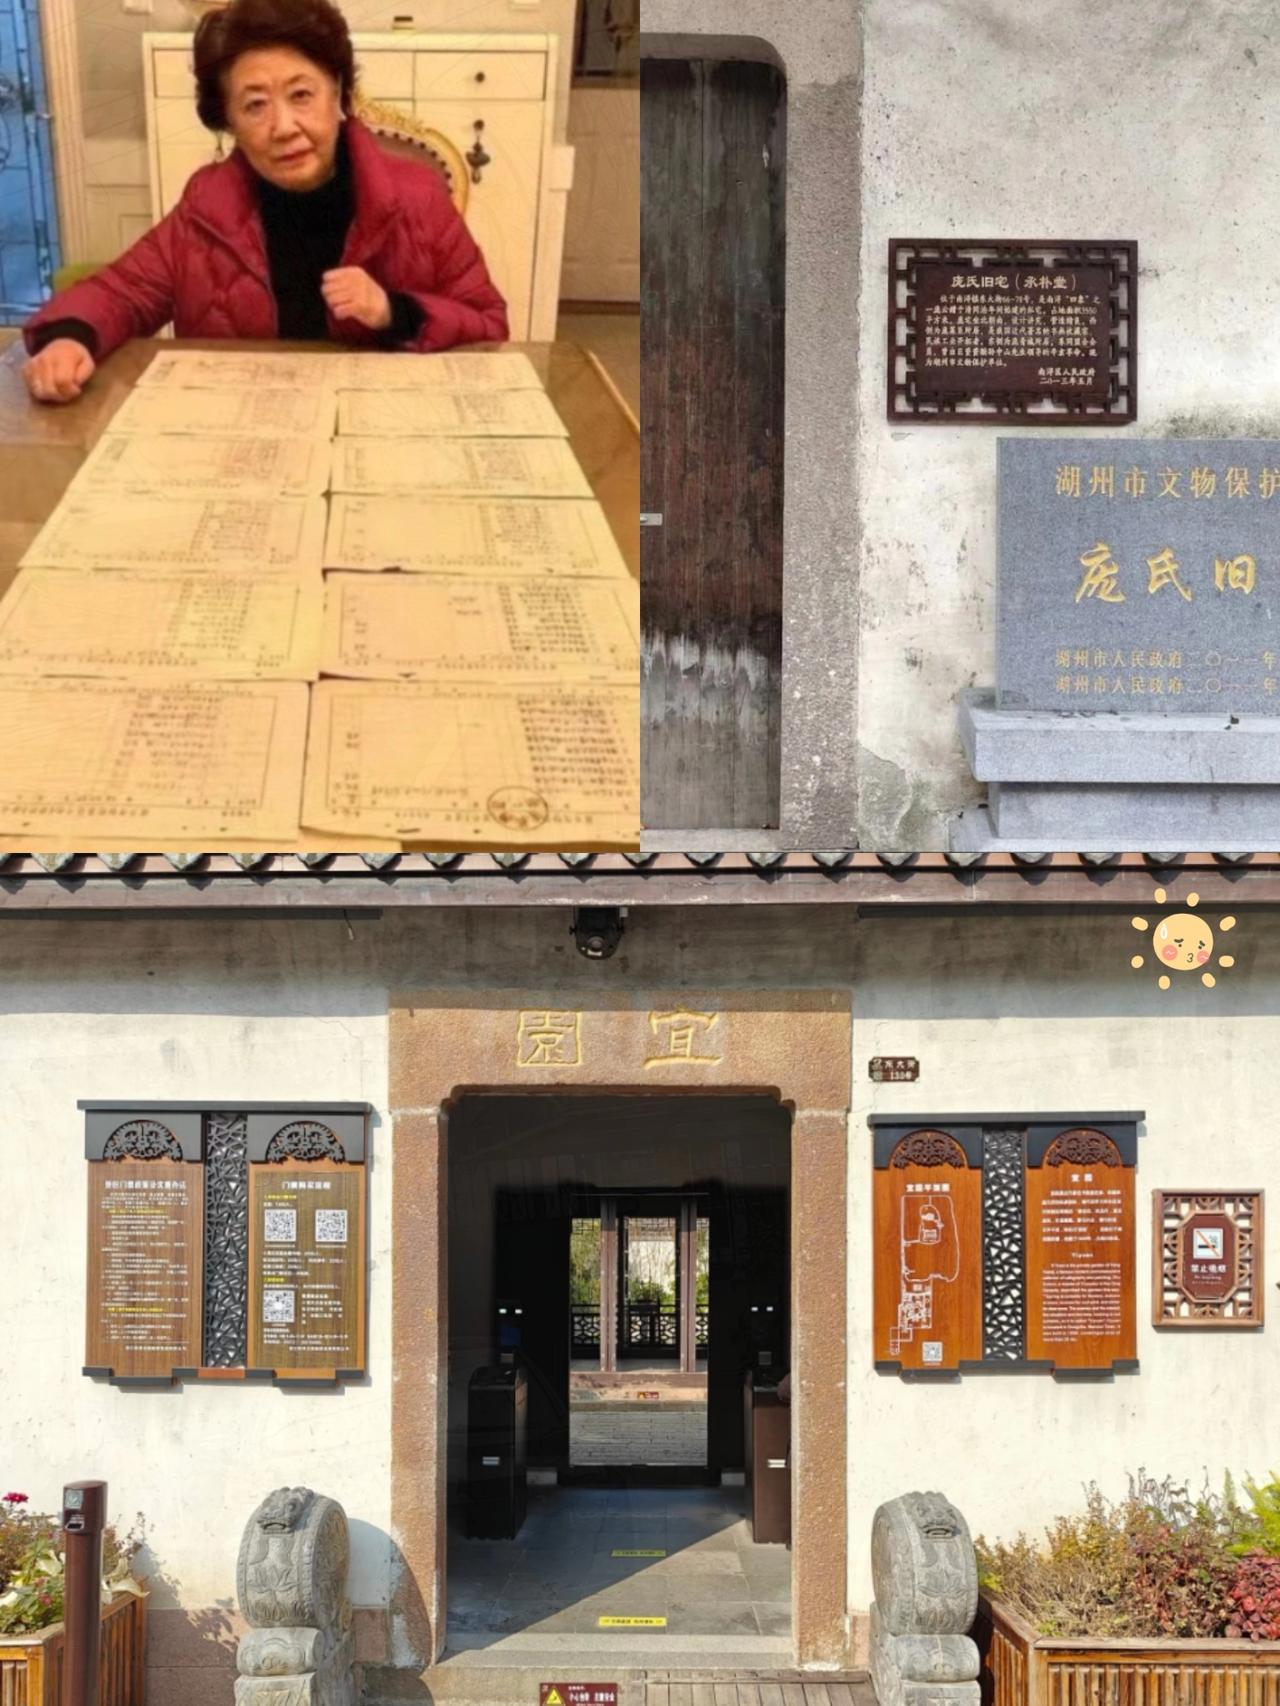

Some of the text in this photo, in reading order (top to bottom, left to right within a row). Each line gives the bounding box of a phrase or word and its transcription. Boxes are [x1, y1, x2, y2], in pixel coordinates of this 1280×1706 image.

[1038, 367, 1096, 377] 南浔区人民政府
[1056, 464, 1280, 498] 湖州市文物保护
